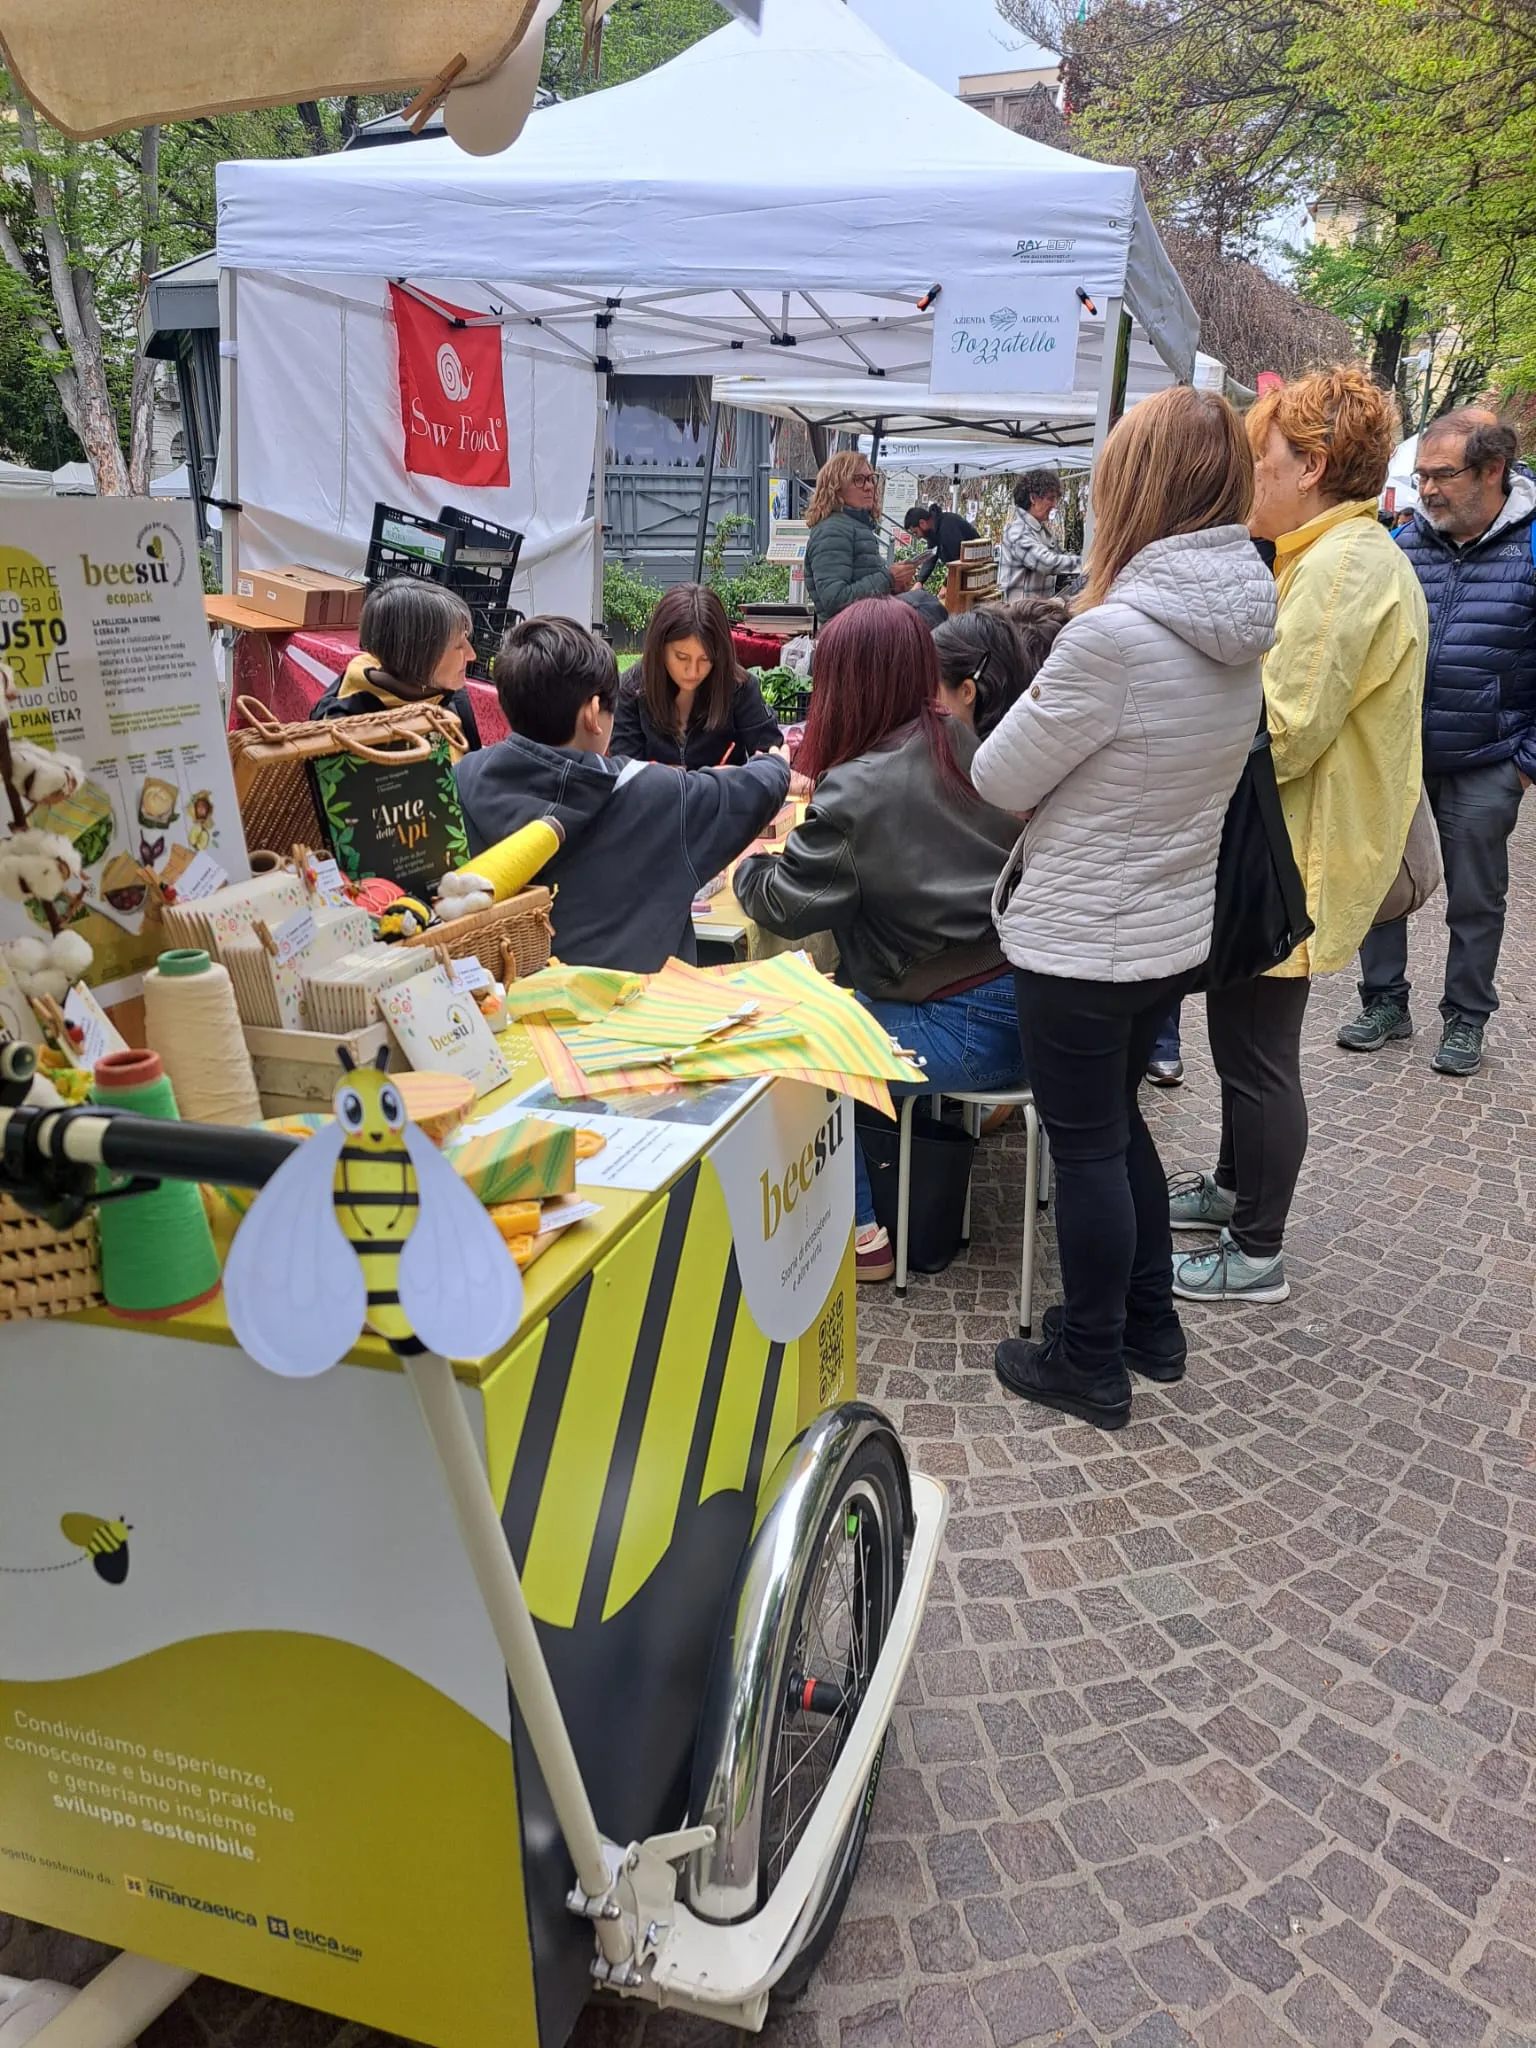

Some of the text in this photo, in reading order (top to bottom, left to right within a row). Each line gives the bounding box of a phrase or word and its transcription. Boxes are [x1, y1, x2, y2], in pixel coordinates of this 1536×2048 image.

[953, 315, 1060, 325] AZIENDA AGRICOLA
[951, 330, 1056, 364] Pozzatello
[7, 565, 59, 589] FARE
[0, 590, 63, 614] cosa di
[106, 589, 153, 607] ecopack
[35, 651, 75, 684] TE
[47, 686, 78, 705] cibo
[20, 707, 82, 728] PIANETA?
[14, 1709, 273, 1793] Condividiamo esperienze,
[4, 1736, 294, 1822] conoscenze e buone pratiche
[47, 1769, 257, 1837] e generiamo insieme
[53, 1793, 261, 1863] sviluppo sostenibile.
[292, 1926, 339, 1951] etica
